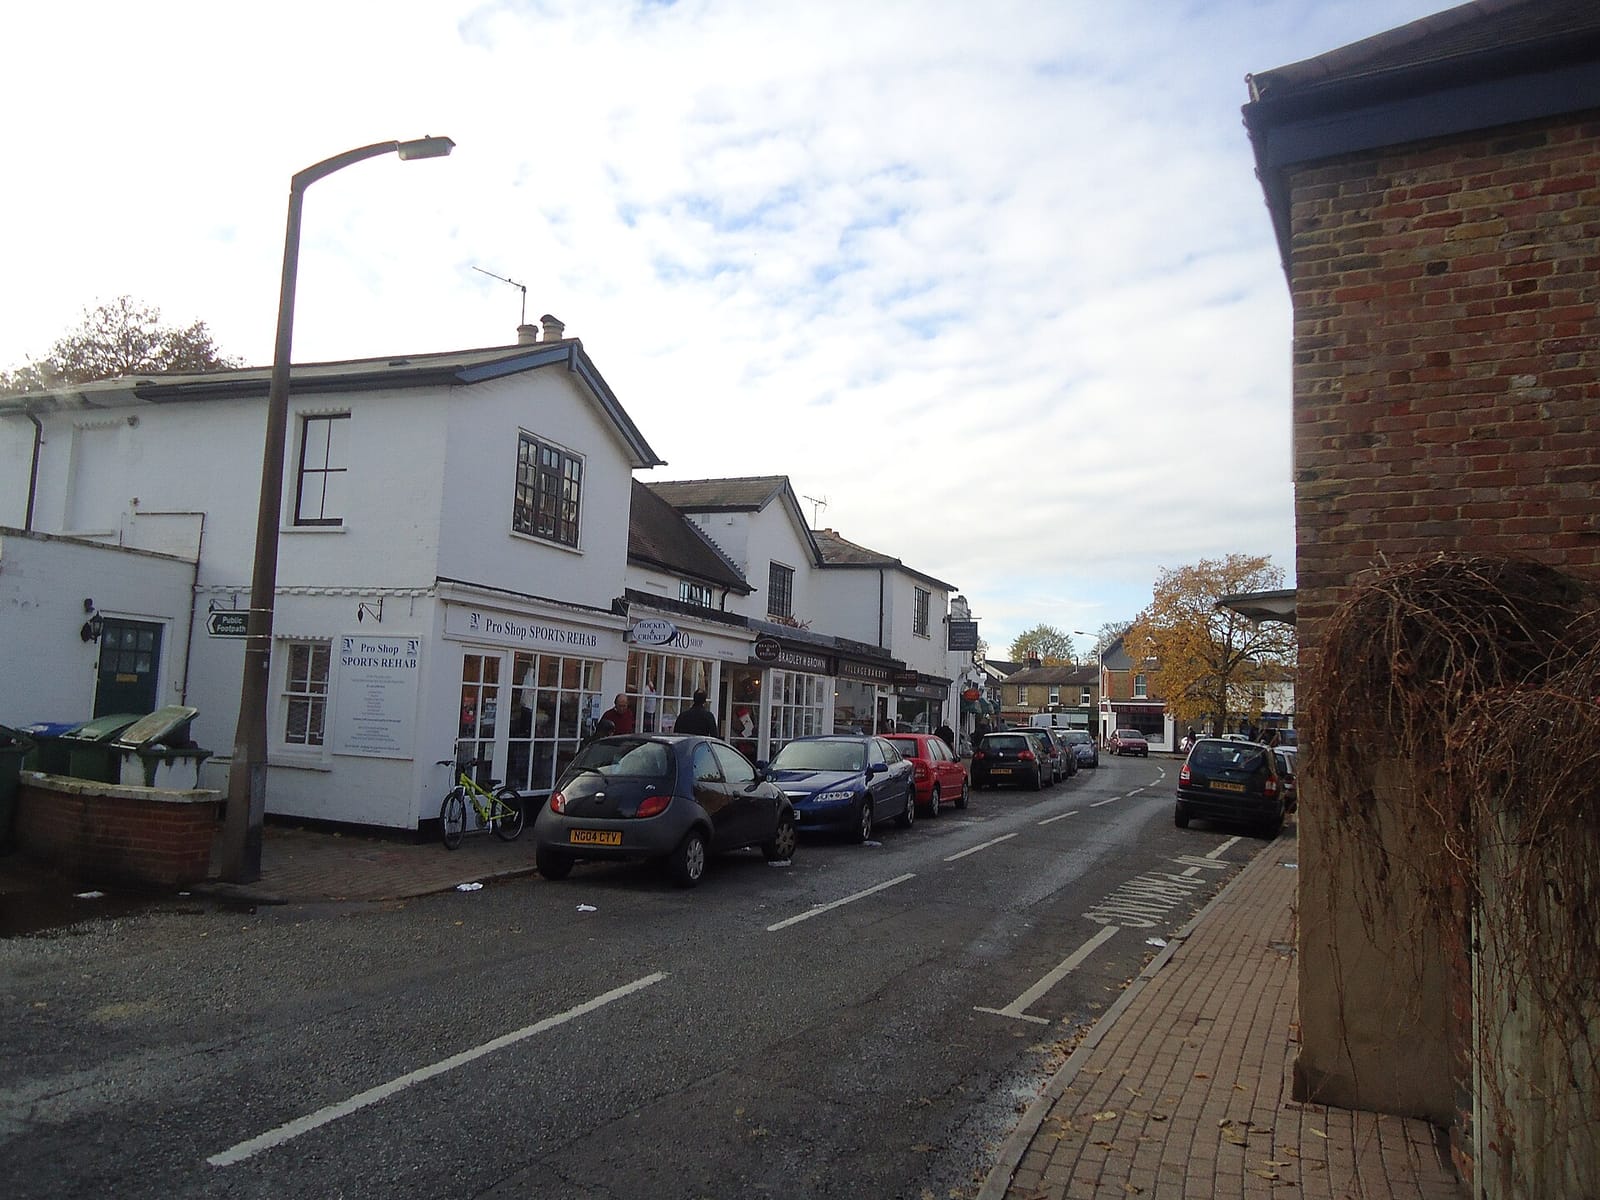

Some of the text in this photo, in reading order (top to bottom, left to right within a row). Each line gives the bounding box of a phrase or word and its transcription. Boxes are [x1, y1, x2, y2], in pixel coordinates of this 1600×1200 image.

[222, 615, 243, 624] Public
[639, 621, 666, 629] HOCKEY
[216, 624, 247, 633] Footpath
[486, 618, 597, 647] Pro Shop SPORTS REHAB
[361, 643, 399, 656] Pro Shop
[341, 656, 417, 669] SPORTS REHAB
[779, 651, 802, 665] BRADLEY
[807, 657, 826, 669] BROWN
